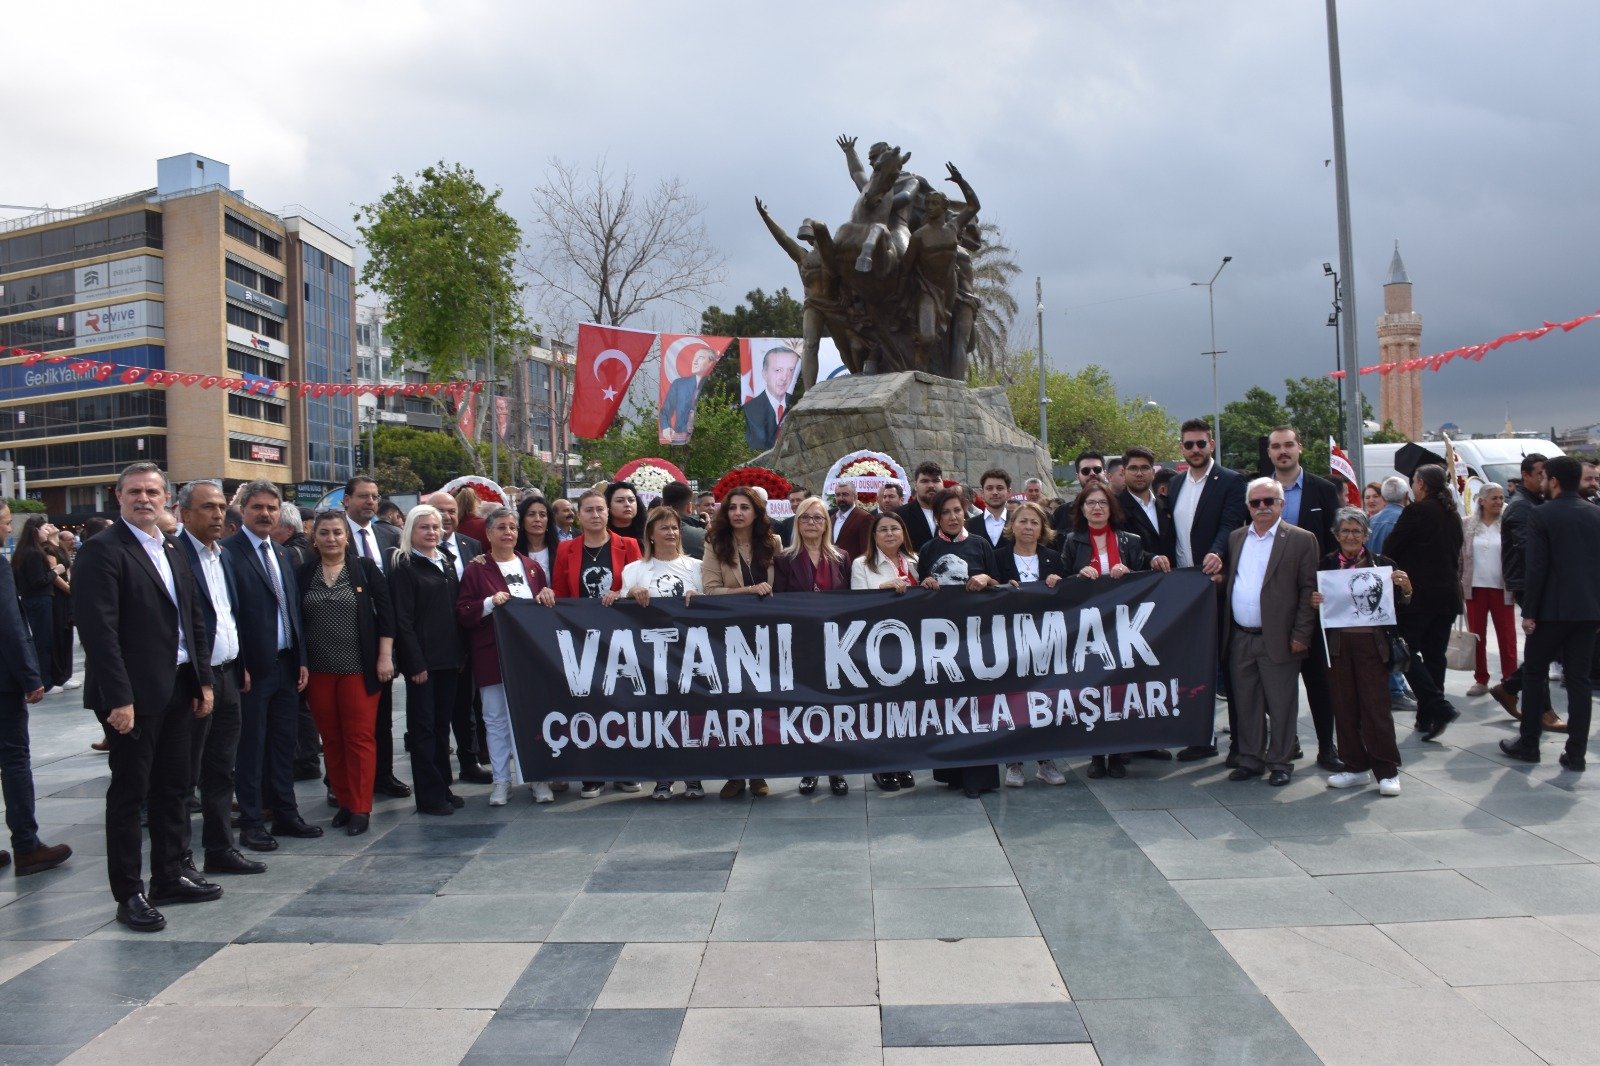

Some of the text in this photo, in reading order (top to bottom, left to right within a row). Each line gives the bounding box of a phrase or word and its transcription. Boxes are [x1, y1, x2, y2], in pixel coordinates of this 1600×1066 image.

[556, 602, 1160, 698] VATANI KORUMAK
[541, 678, 1182, 758] ÇOCUKLARI KORUMAKLA BAŞLAR!
